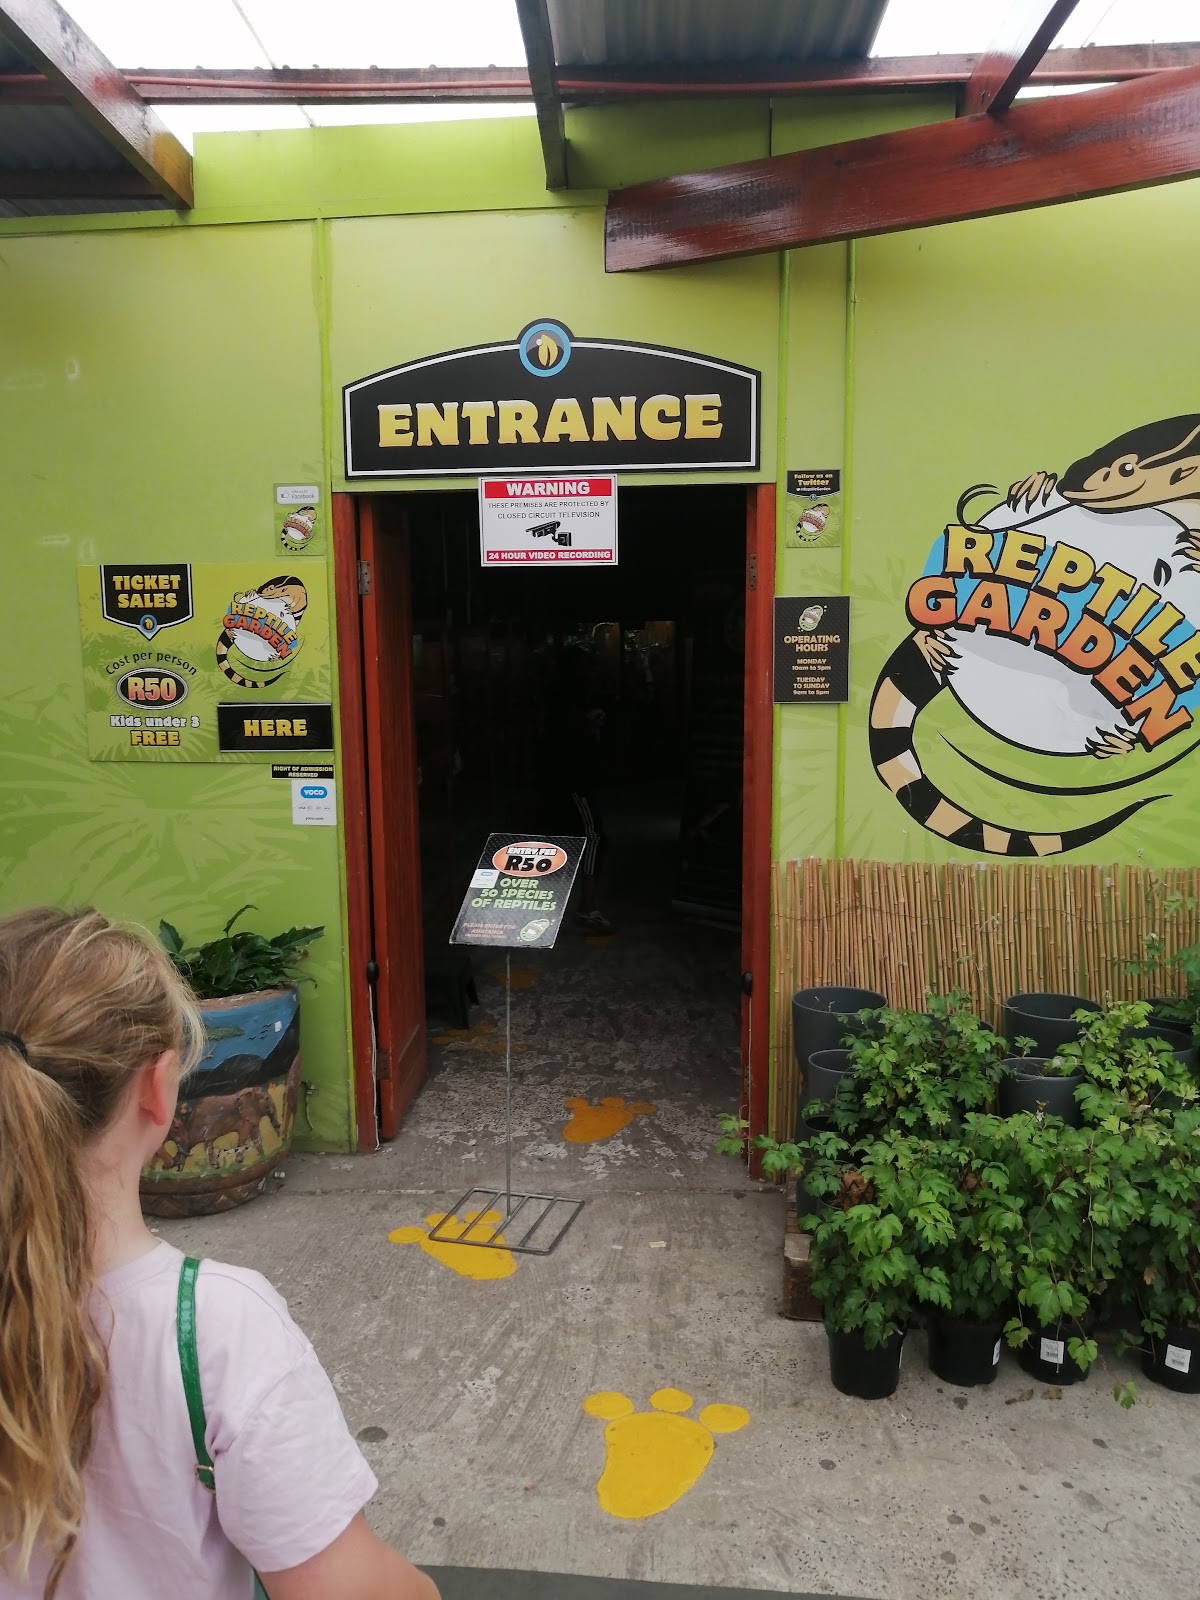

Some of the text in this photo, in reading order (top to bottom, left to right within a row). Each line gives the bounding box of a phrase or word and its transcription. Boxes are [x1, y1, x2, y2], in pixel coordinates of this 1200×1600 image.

[377, 394, 723, 447] ENTRANCE
[506, 482, 590, 496] WARNING
[488, 550, 611, 560] 24 HOUR VIDEO RECORDING
[112, 574, 181, 590] TICKET
[117, 592, 177, 609] SALES
[942, 524, 1200, 698] REPTILE
[231, 601, 298, 645] REPTILE
[223, 614, 293, 660] GARDEN
[783, 634, 841, 644] OPERATING
[795, 643, 829, 652] HOURS
[105, 651, 197, 676] Cost per person
[905, 574, 1194, 752] GARDEN
[127, 676, 177, 701] R50
[110, 715, 142, 727] Kids
[145, 716, 187, 728] under
[243, 719, 308, 737] HERE
[130, 730, 180, 746] FREE
[506, 847, 539, 855] ENTRY
[504, 855, 552, 872] R50
[500, 878, 539, 889] OVER
[480, 889, 554, 900] 50 SPECIES
[471, 898, 557, 911] OF REPTILES
